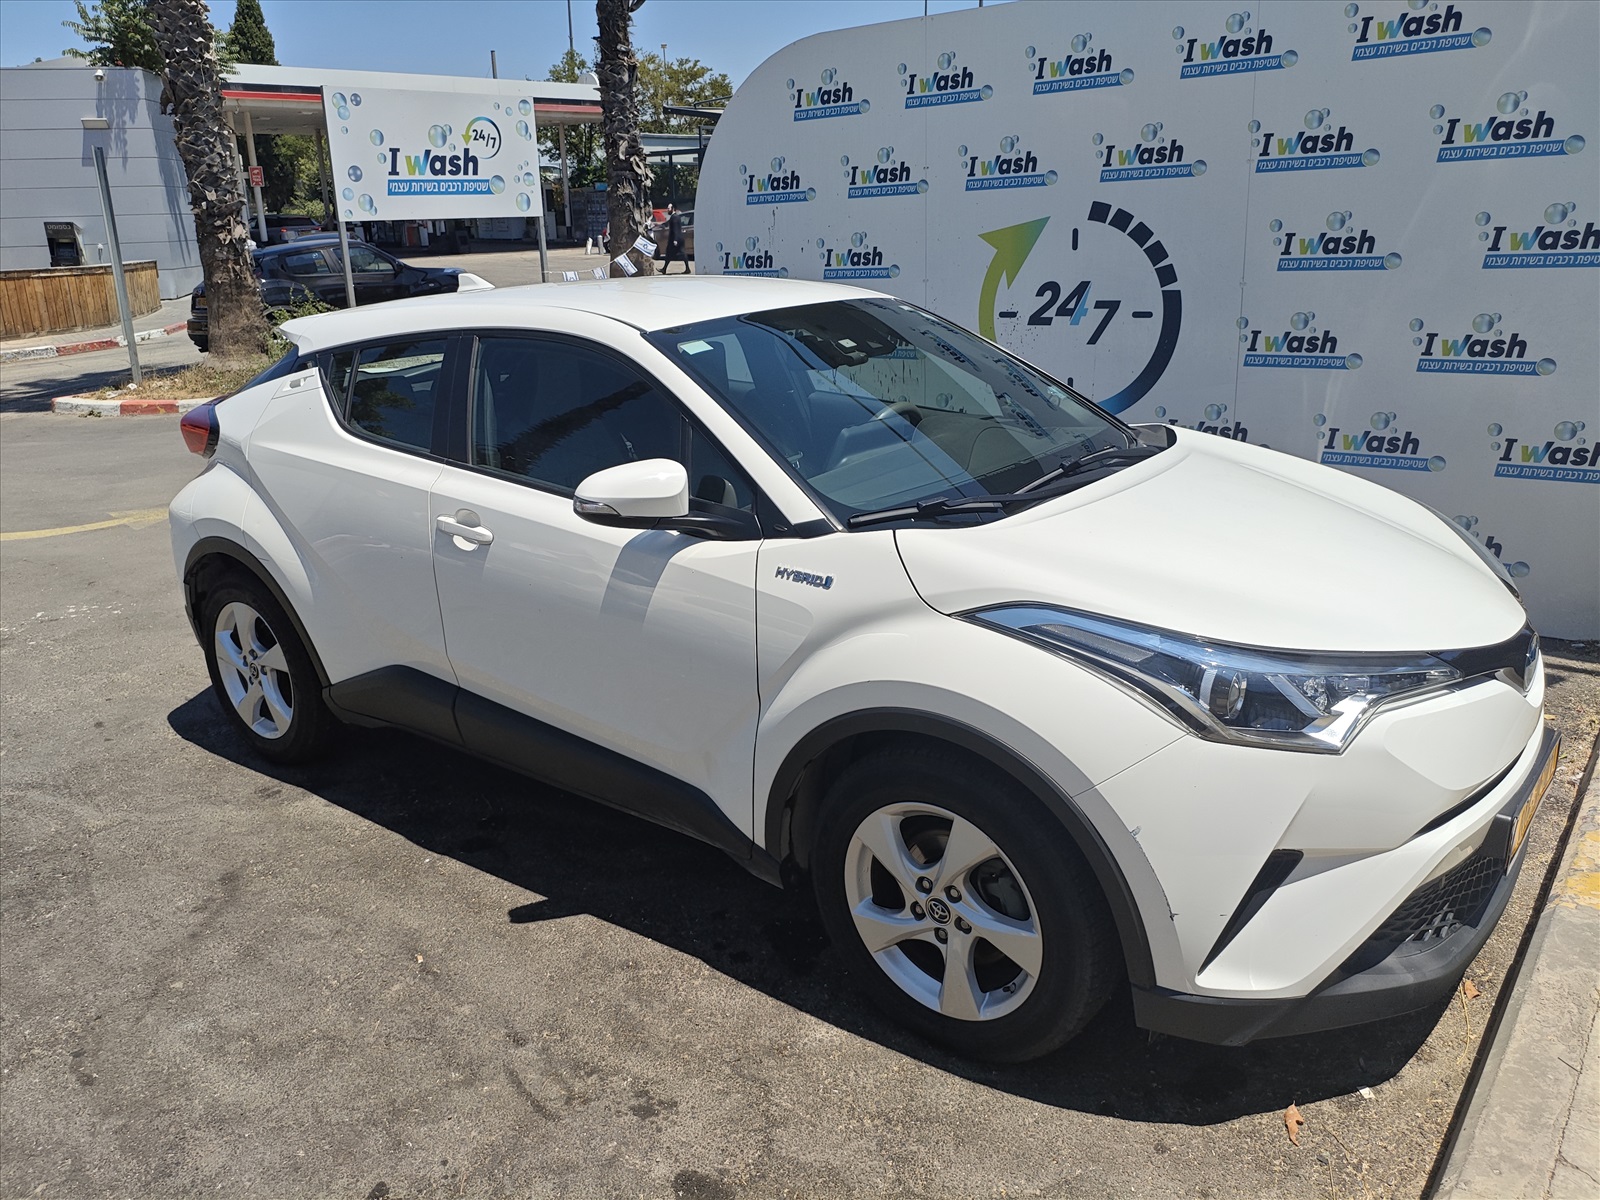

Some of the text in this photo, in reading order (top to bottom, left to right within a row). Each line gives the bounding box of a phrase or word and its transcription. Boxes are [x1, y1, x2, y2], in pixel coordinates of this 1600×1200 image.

[1356, 4, 1462, 43] I Wash
[1183, 29, 1272, 62] I Wash
[1035, 49, 1111, 80] I Wash
[907, 66, 973, 95] I Wash
[795, 82, 852, 108] I Wash
[472, 129, 496, 149] 24/7
[1442, 111, 1554, 144] I Wash
[1102, 139, 1183, 167] I Wash
[1259, 126, 1353, 156] I Wash
[388, 148, 478, 176] I Wash
[849, 161, 910, 185] I Wash
[967, 151, 1037, 177] I Wash
[390, 182, 488, 192] שטיפת רכבים בשירות עצמי
[747, 170, 799, 192] I Wash
[1280, 229, 1375, 256] I Wash
[1487, 222, 1600, 252] I Wash
[724, 250, 773, 269] I Wash
[825, 246, 882, 267] I Wash
[1576, 255, 1600, 264] טיפת
[1247, 330, 1337, 354] I Wash
[1421, 333, 1527, 358] I Wash
[1181, 422, 1248, 442] ash
[1325, 427, 1420, 455] I Wash
[1499, 438, 1518, 462] I
[775, 566, 824, 588] HYBRID
